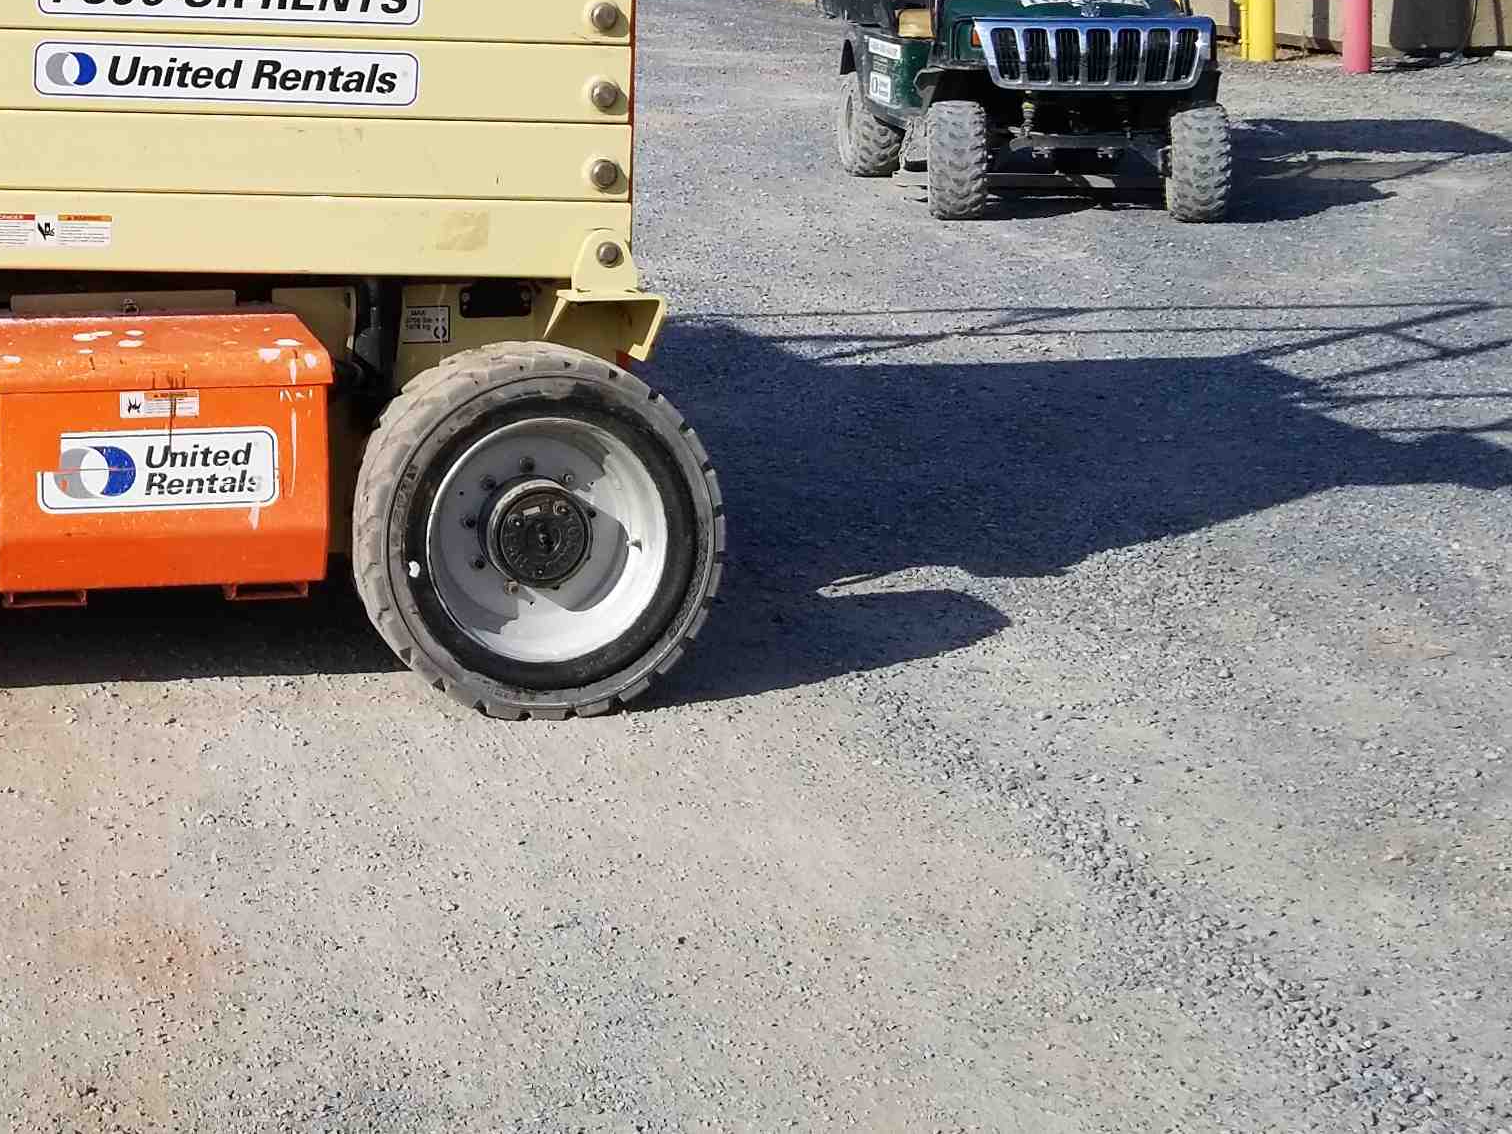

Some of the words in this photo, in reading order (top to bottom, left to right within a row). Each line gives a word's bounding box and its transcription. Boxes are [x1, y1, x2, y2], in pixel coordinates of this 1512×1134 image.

[107, 55, 243, 89] United
[251, 59, 398, 94] Rentals
[145, 442, 253, 469] United
[144, 468, 263, 497] Rentals
